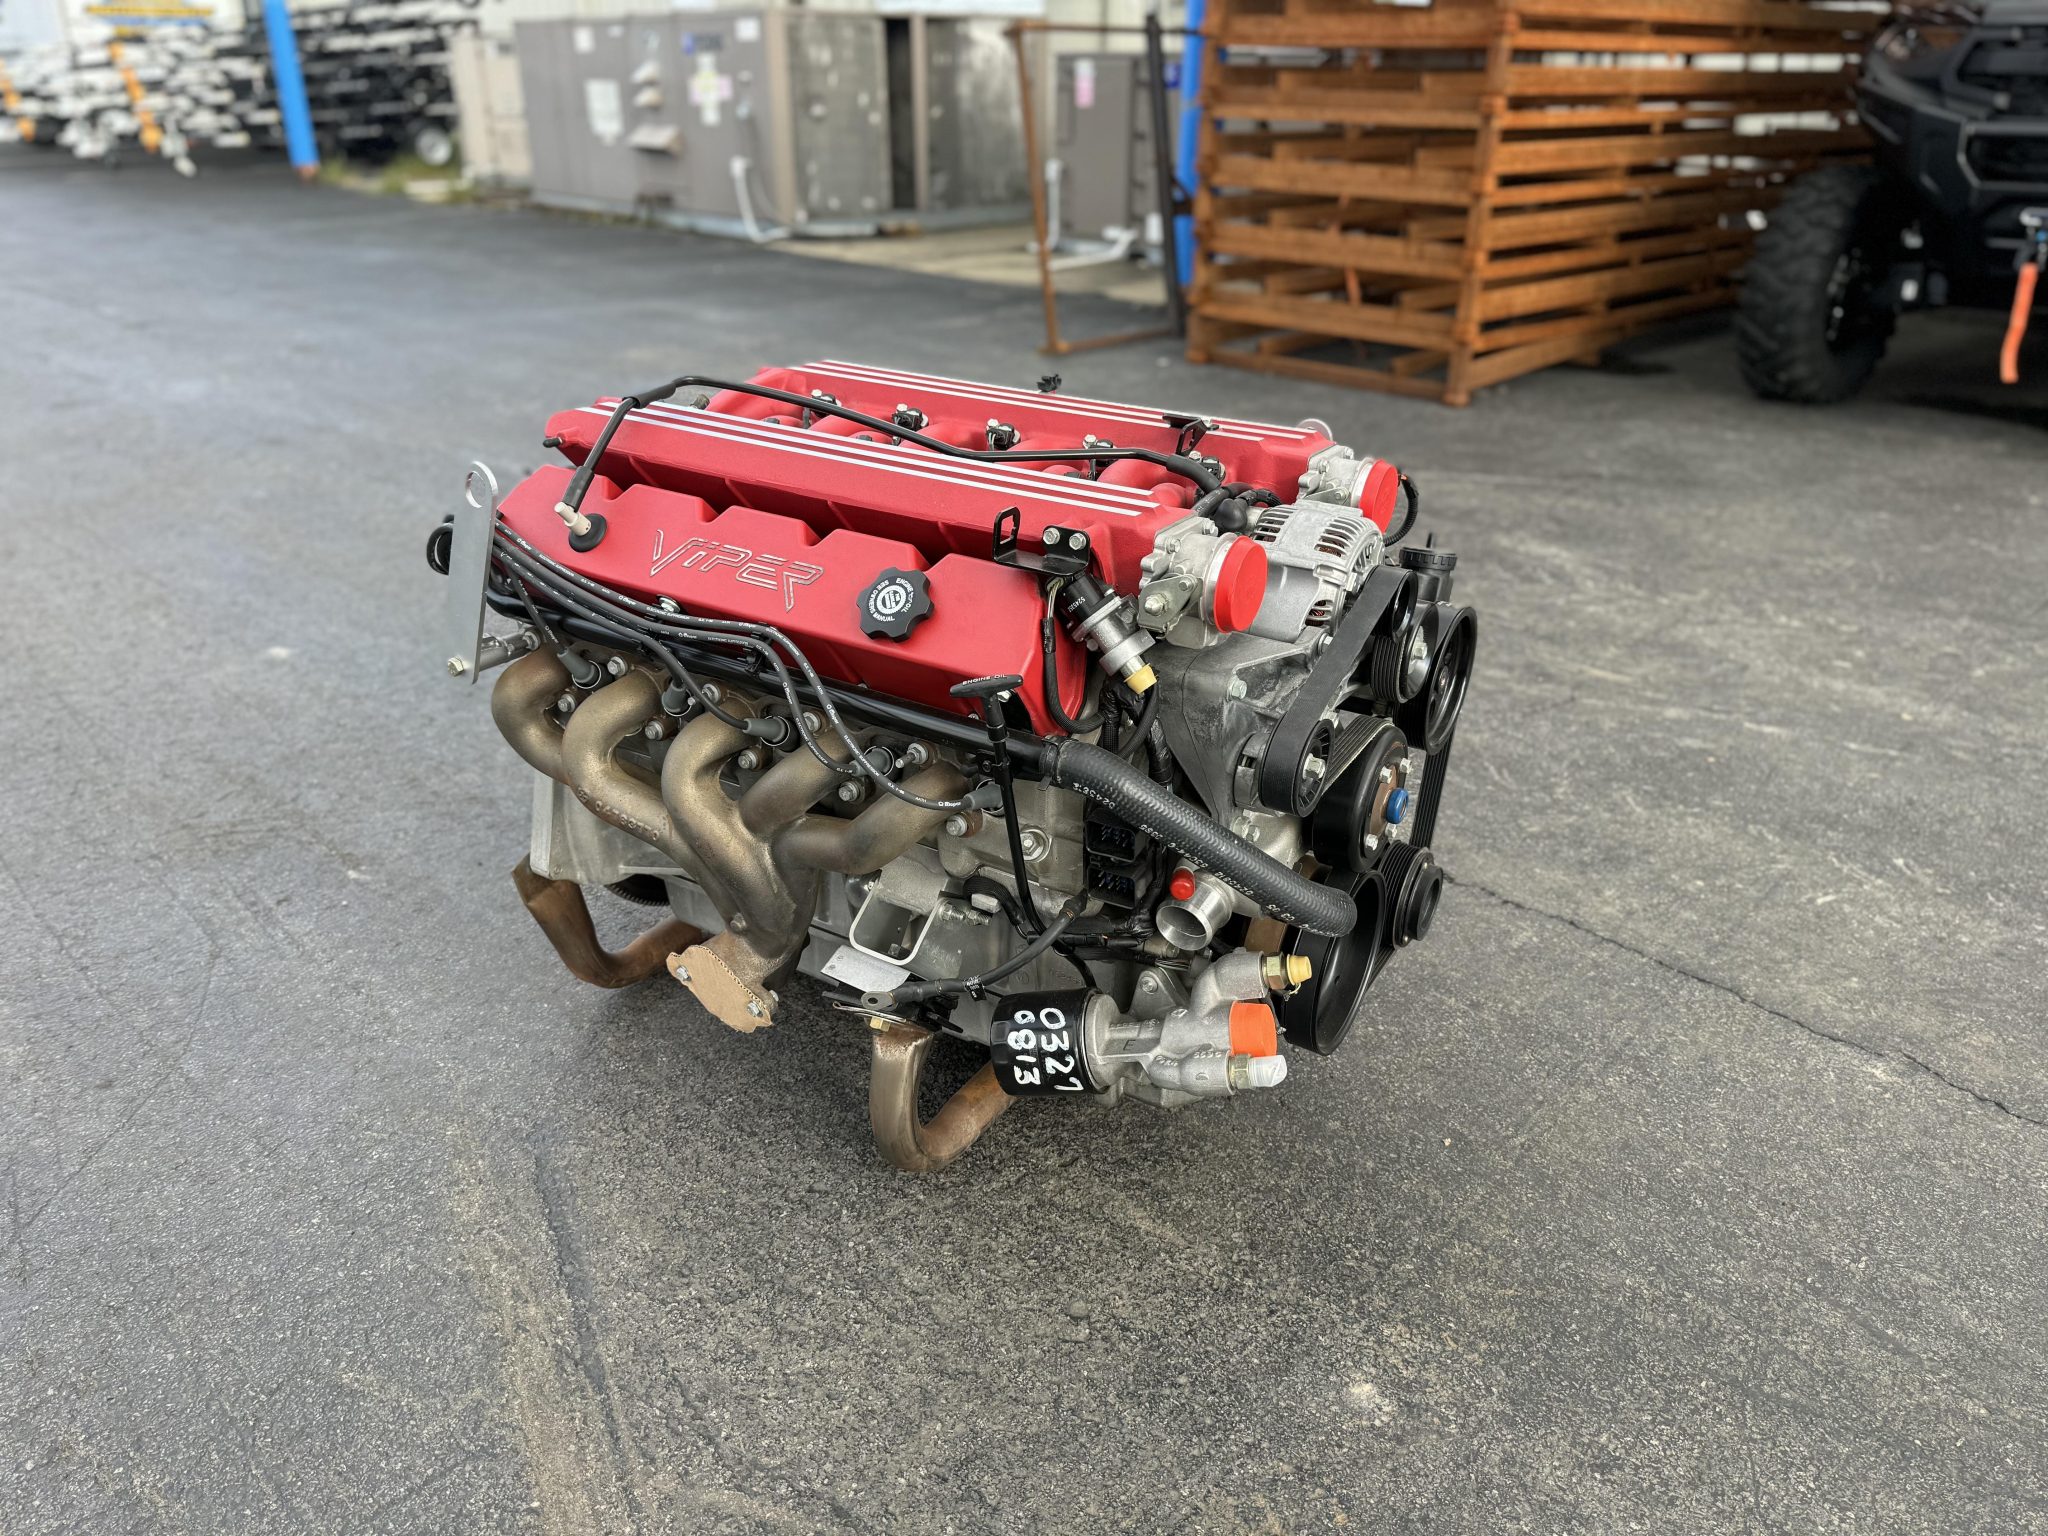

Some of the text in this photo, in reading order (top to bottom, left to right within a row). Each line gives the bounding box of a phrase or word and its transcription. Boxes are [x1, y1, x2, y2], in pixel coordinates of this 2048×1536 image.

[649, 529, 824, 613] VIPER
[895, 577, 914, 613] ENGINE OIL
[962, 673, 1008, 686] ENGINE OIL
[1006, 1009, 1041, 1090] 0813
[1039, 1007, 1085, 1092] 0327
